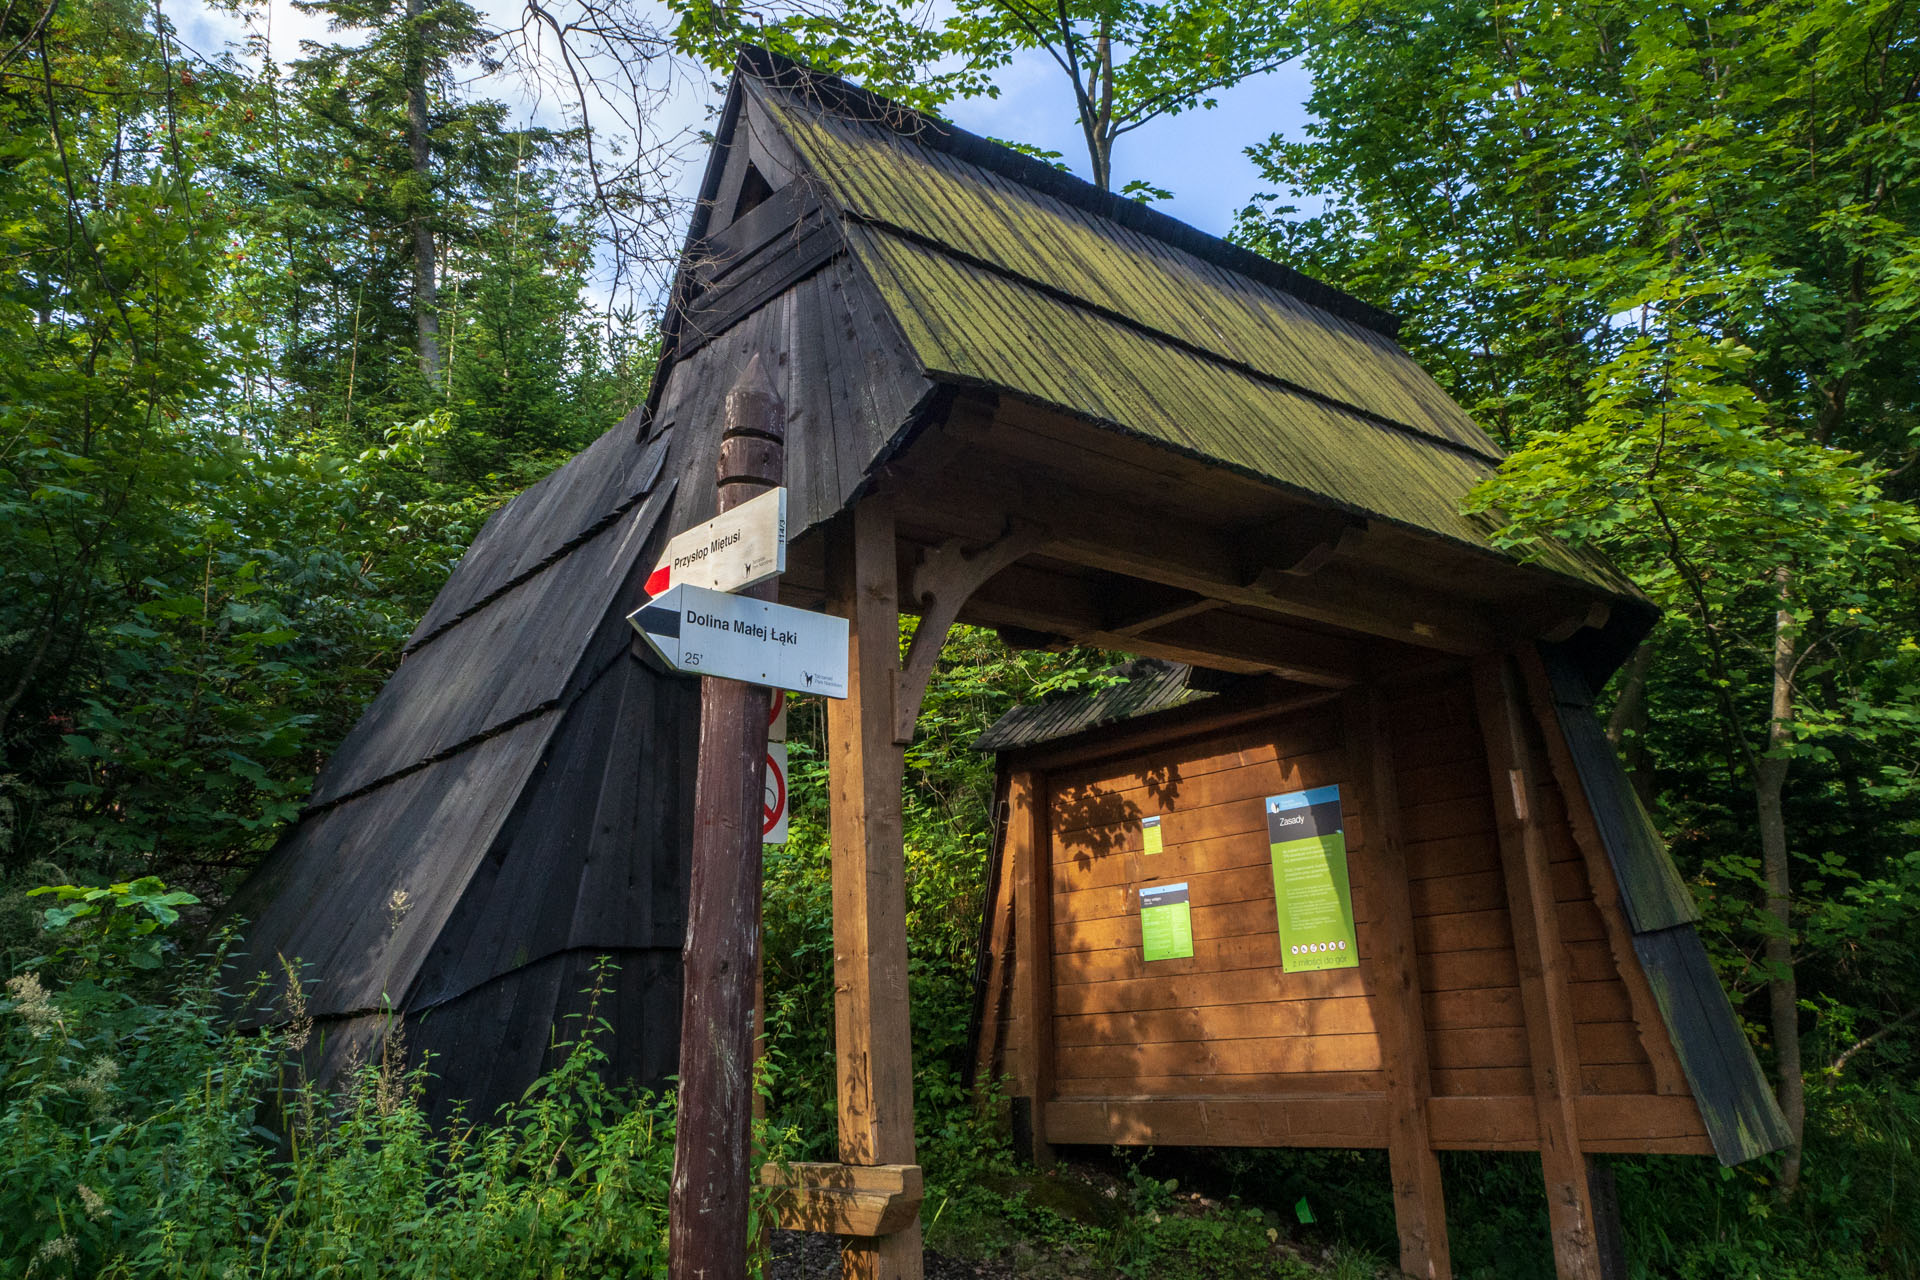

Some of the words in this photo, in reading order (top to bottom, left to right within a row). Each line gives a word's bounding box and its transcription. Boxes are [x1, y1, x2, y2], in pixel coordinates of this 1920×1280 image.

[674, 547, 708, 570] Przysłop
[711, 529, 741, 552] Miętusi
[687, 610, 729, 631] Dolina
[734, 620, 767, 641] Małej
[771, 628, 797, 646] Łąki
[685, 652, 703, 666] 25'
[1279, 815, 1305, 827] Zasady
